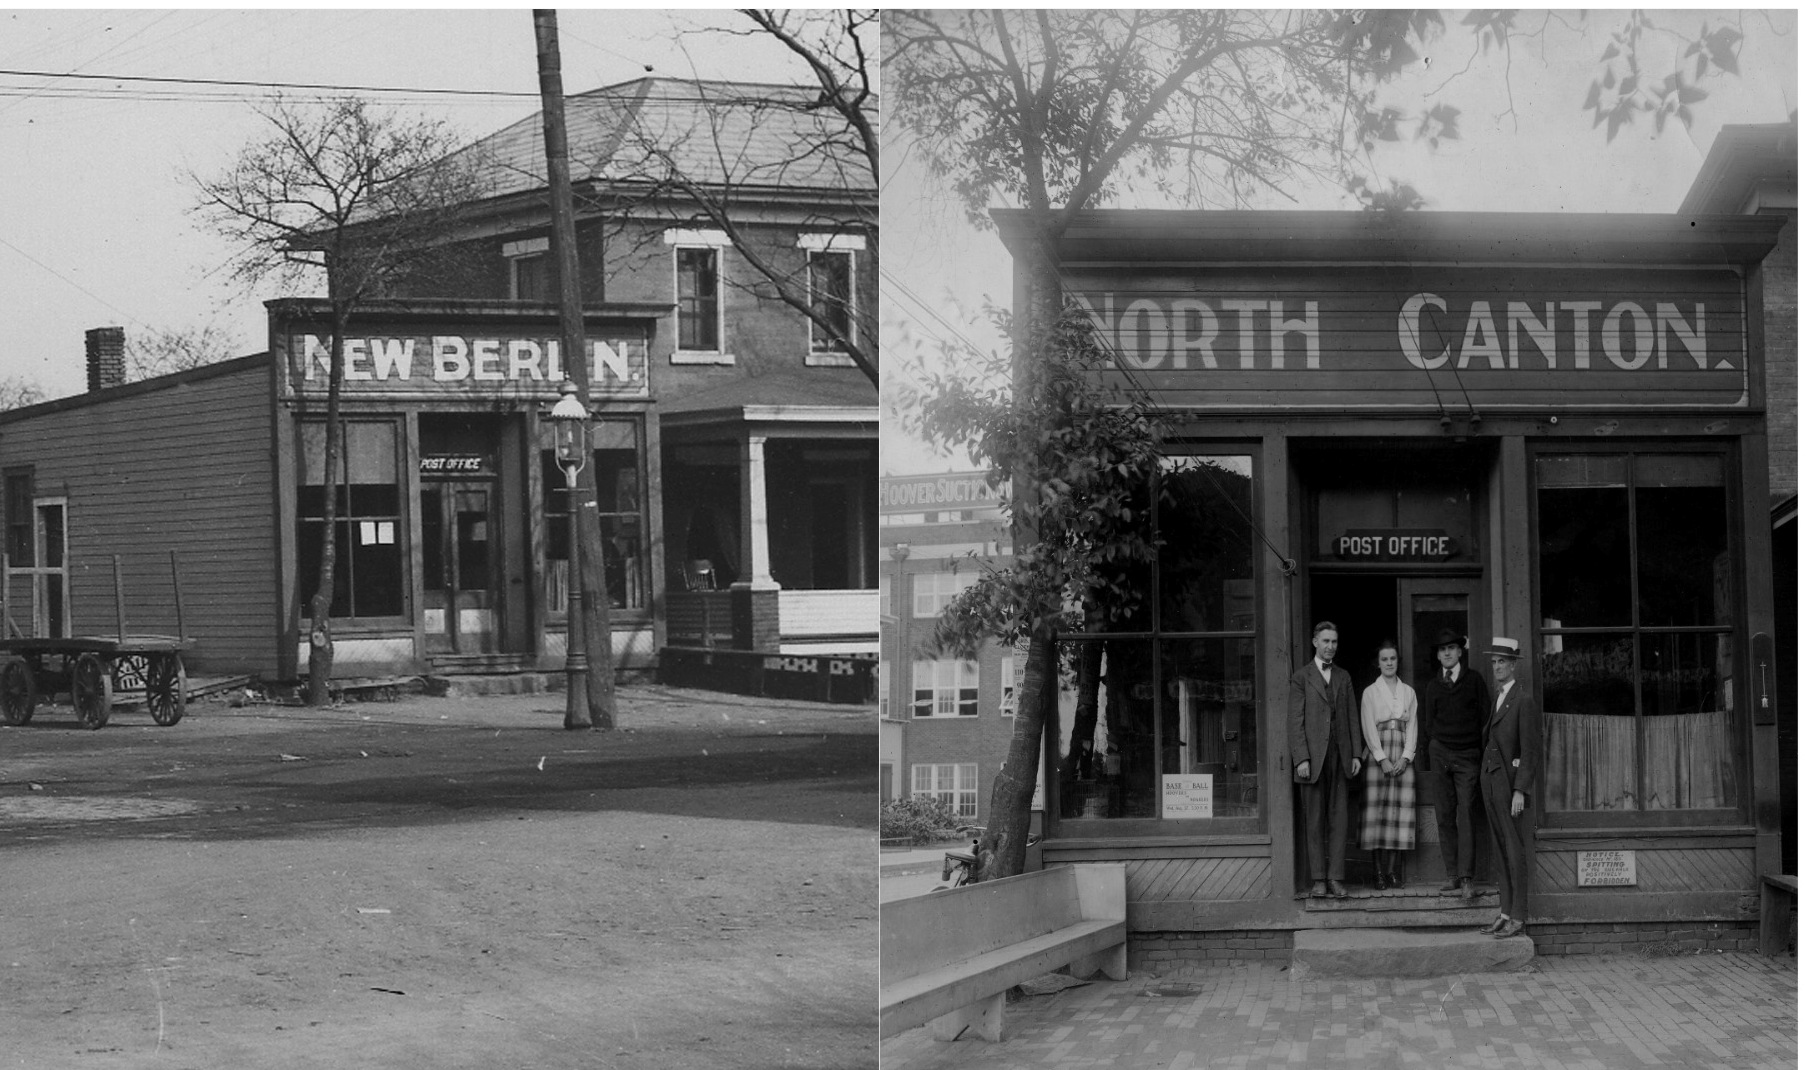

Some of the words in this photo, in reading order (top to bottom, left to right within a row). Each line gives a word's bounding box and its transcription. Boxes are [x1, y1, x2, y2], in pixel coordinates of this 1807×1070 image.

[1062, 292, 1320, 370] NORTH
[304, 334, 415, 381] NEW
[432, 335, 640, 382] BERLN.
[420, 457, 446, 470] POST
[446, 457, 482, 470] OFFICE
[880, 481, 936, 506] HOOVER
[1340, 536, 1383, 555] POST
[1388, 536, 1449, 555] OFFICE
[1165, 782, 1182, 790] BASE
